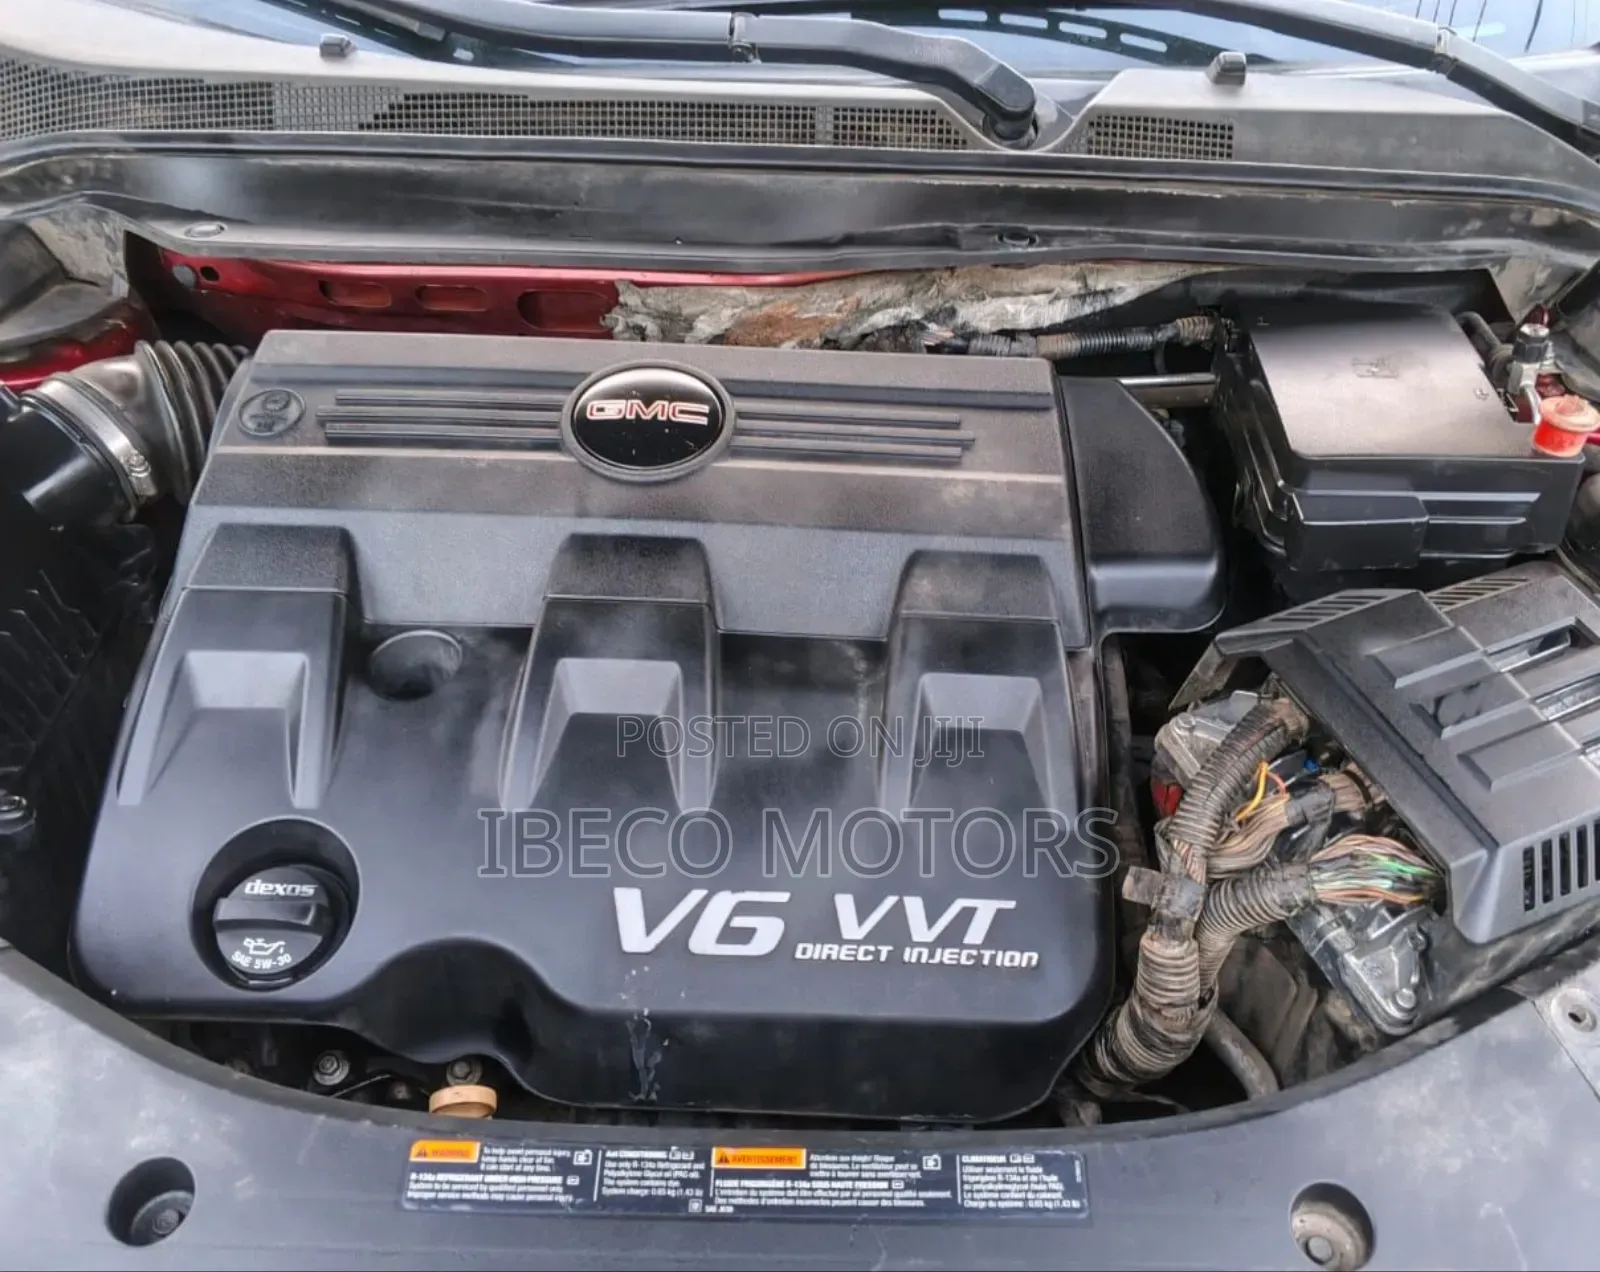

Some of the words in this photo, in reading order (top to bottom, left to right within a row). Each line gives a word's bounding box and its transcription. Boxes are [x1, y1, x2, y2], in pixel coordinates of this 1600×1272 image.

[586, 399, 710, 426] GMC
[244, 879, 318, 897] dexos
[613, 886, 791, 957] V6
[833, 893, 1017, 945] VVT
[231, 950, 253, 969] SAE
[253, 952, 292, 970] 5W-30
[794, 943, 893, 963] DIRECT
[903, 946, 1040, 968] INJECTION
